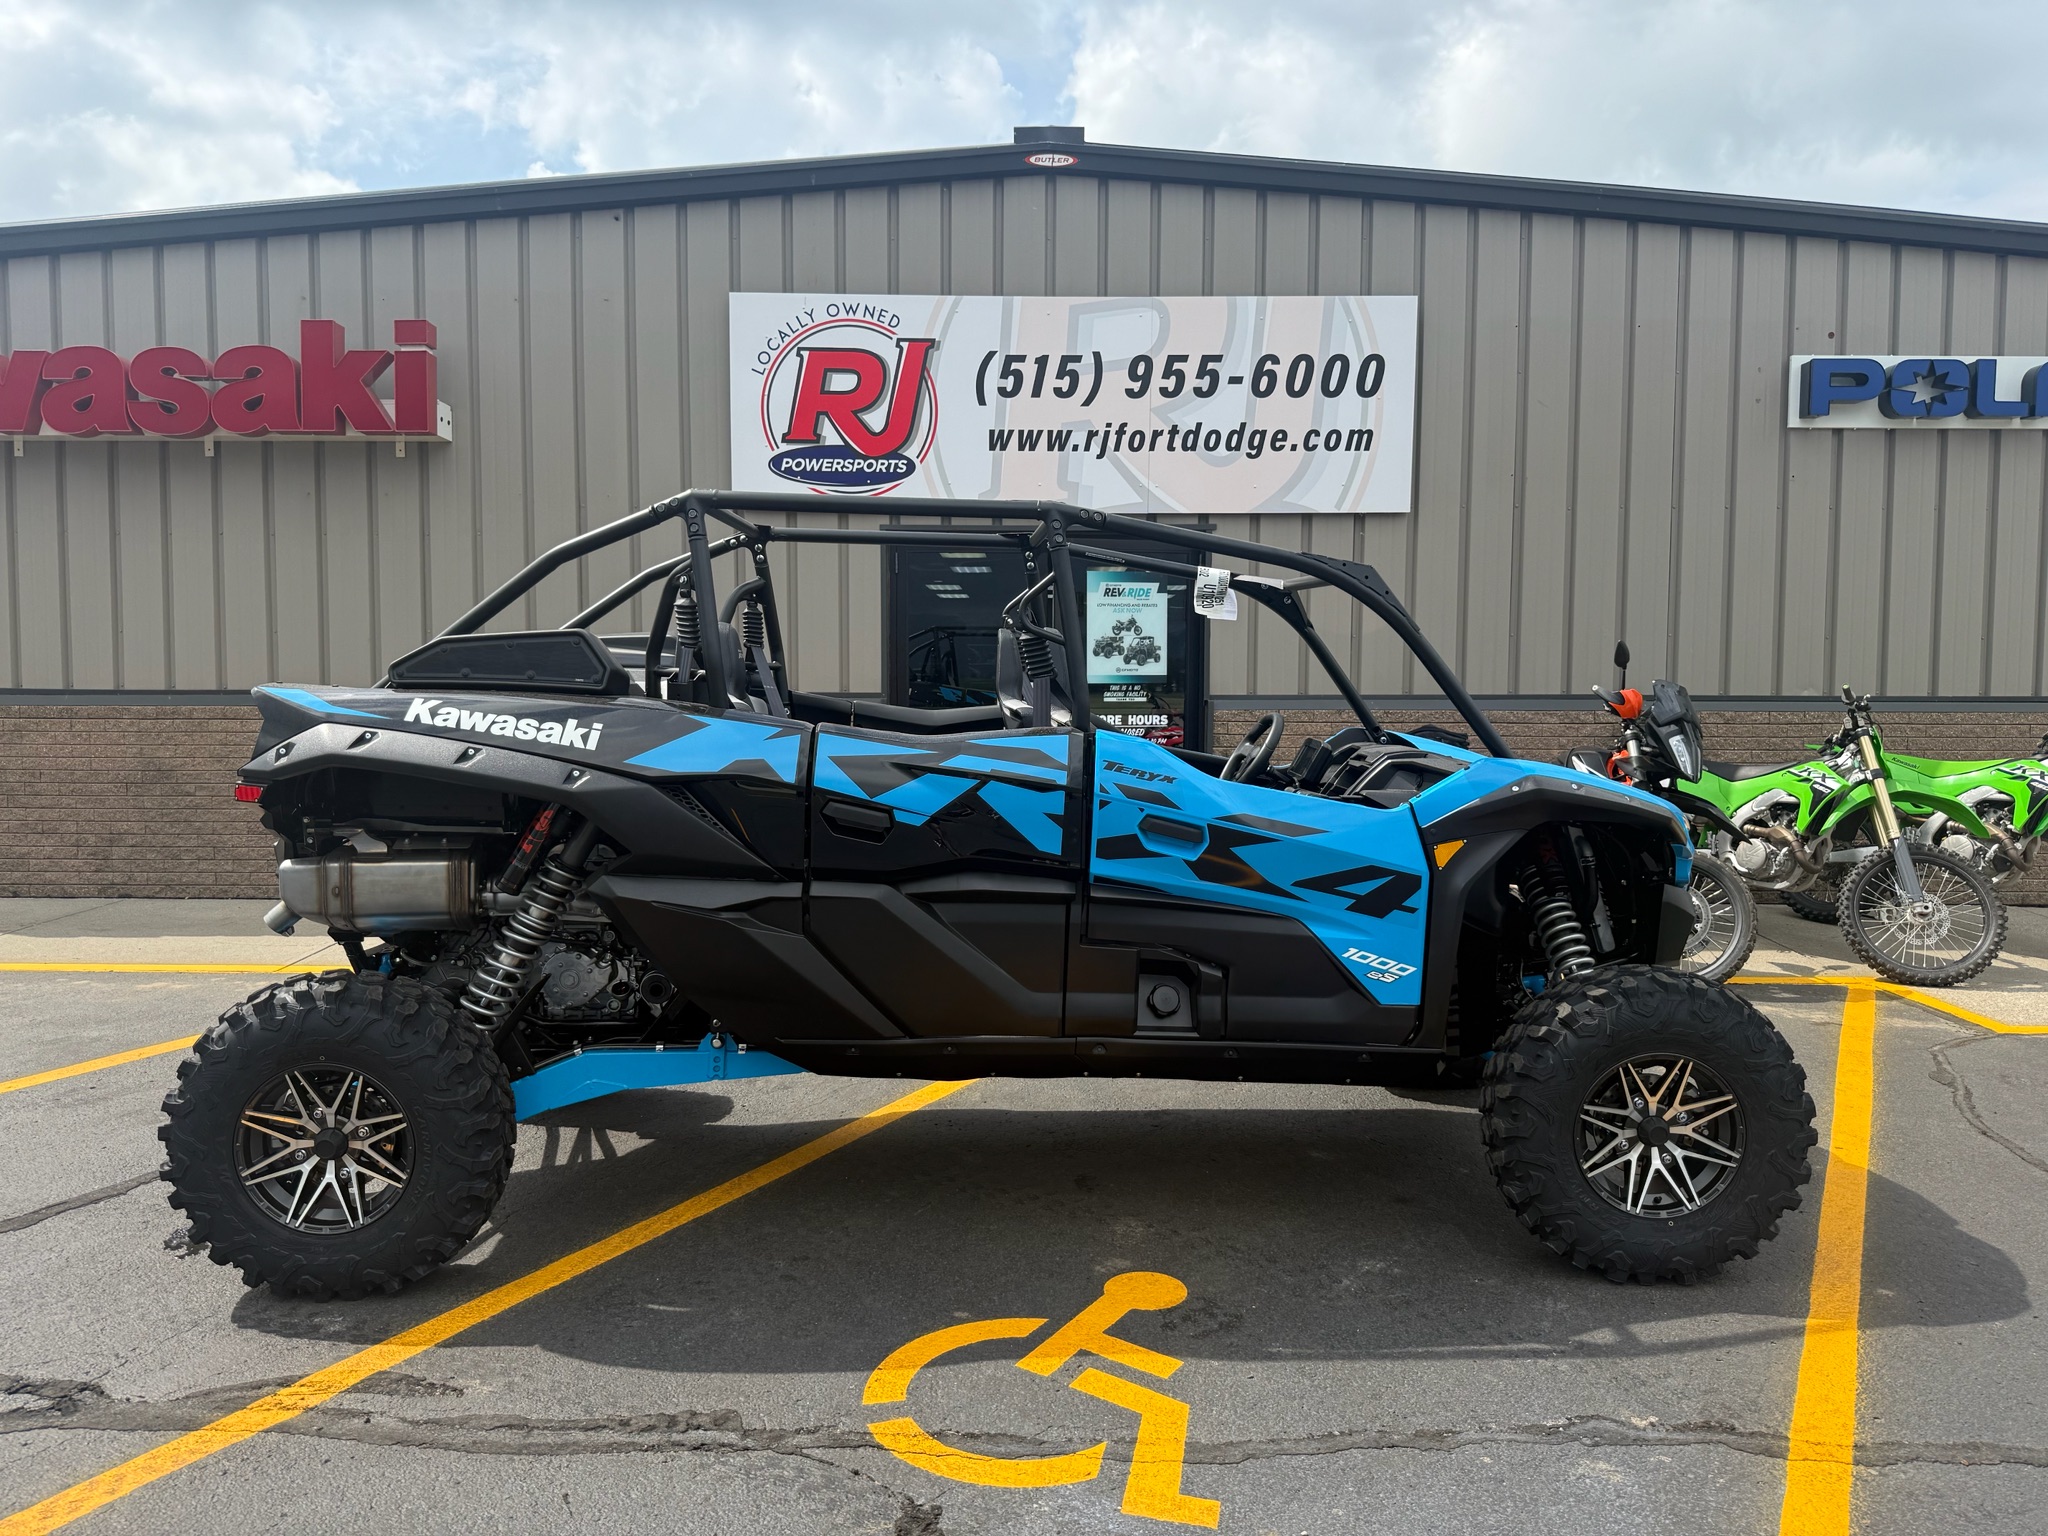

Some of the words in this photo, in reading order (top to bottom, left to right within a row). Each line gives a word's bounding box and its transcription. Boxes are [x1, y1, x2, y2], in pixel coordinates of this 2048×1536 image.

[1034, 156, 1070, 164] BUTLER
[751, 307, 816, 376] LOCALLY
[826, 302, 901, 329] OWNED
[781, 337, 941, 458] RJ
[975, 350, 1103, 407] (515)
[1124, 353, 1386, 399] 955-6000
[987, 422, 1374, 459] www.rjfortdodge.com
[780, 457, 908, 473] POWERSPORTS
[403, 698, 604, 751] Kawasaki
[1127, 714, 1168, 726] HOURS
[1290, 864, 1422, 919] 4
[1341, 947, 1418, 976] 1000
